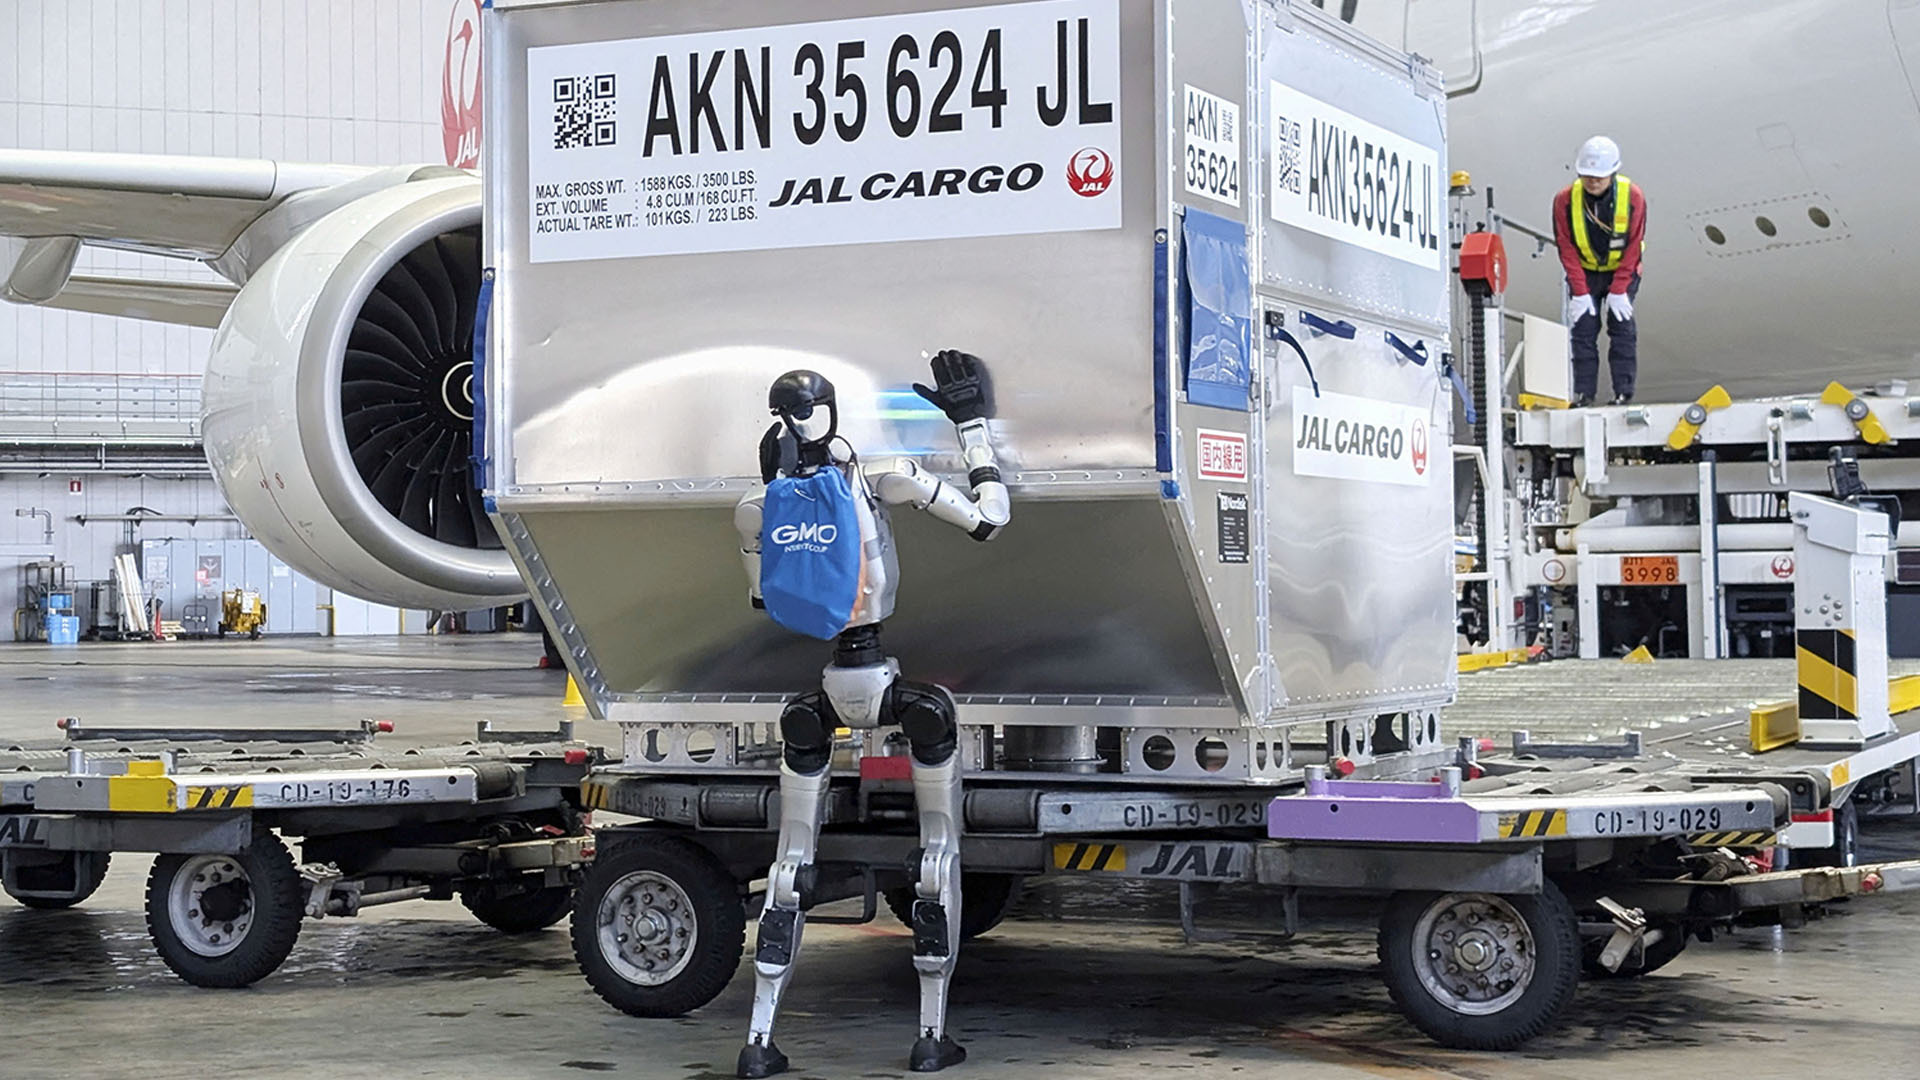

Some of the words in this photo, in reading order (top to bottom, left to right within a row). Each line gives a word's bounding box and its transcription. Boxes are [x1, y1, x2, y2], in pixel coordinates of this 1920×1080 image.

[642, 46, 771, 158] AKN
[1036, 18, 1113, 127] JL
[1187, 91, 1218, 143] AKN
[454, 126, 478, 168] JAL
[536, 183, 562, 199] MAX.
[565, 181, 604, 197] GROSS
[606, 179, 626, 194] WT.
[641, 176, 666, 191] 1588
[668, 174, 695, 189] KGS.
[703, 172, 729, 187] 3500
[732, 170, 757, 185] LBS.
[769, 176, 853, 207] JAL
[860, 162, 1044, 200] CARGO
[1187, 144, 1238, 200] 35624
[1079, 182, 1104, 192] JAL
[536, 201, 560, 216] EXT.
[562, 198, 608, 214] VOLUME
[646, 194, 662, 209] 4.8
[665, 192, 694, 207] CU.M
[721, 188, 757, 204] CU.FT.
[536, 217, 581, 233] ACTUAL
[583, 215, 613, 231] TARE
[645, 212, 664, 226] 101
[665, 209, 694, 225] KGS.
[708, 207, 728, 222] 223
[731, 205, 758, 221] LBS.
[1202, 441, 1243, 471] 国内線用
[771, 522, 837, 544] GMO
[1624, 566, 1676, 582] 3998
[1123, 802, 1263, 828] CD-19-029
[1595, 807, 1721, 834] CD-19-029
[0, 816, 45, 846] AL
[1140, 843, 1243, 879] JAL
